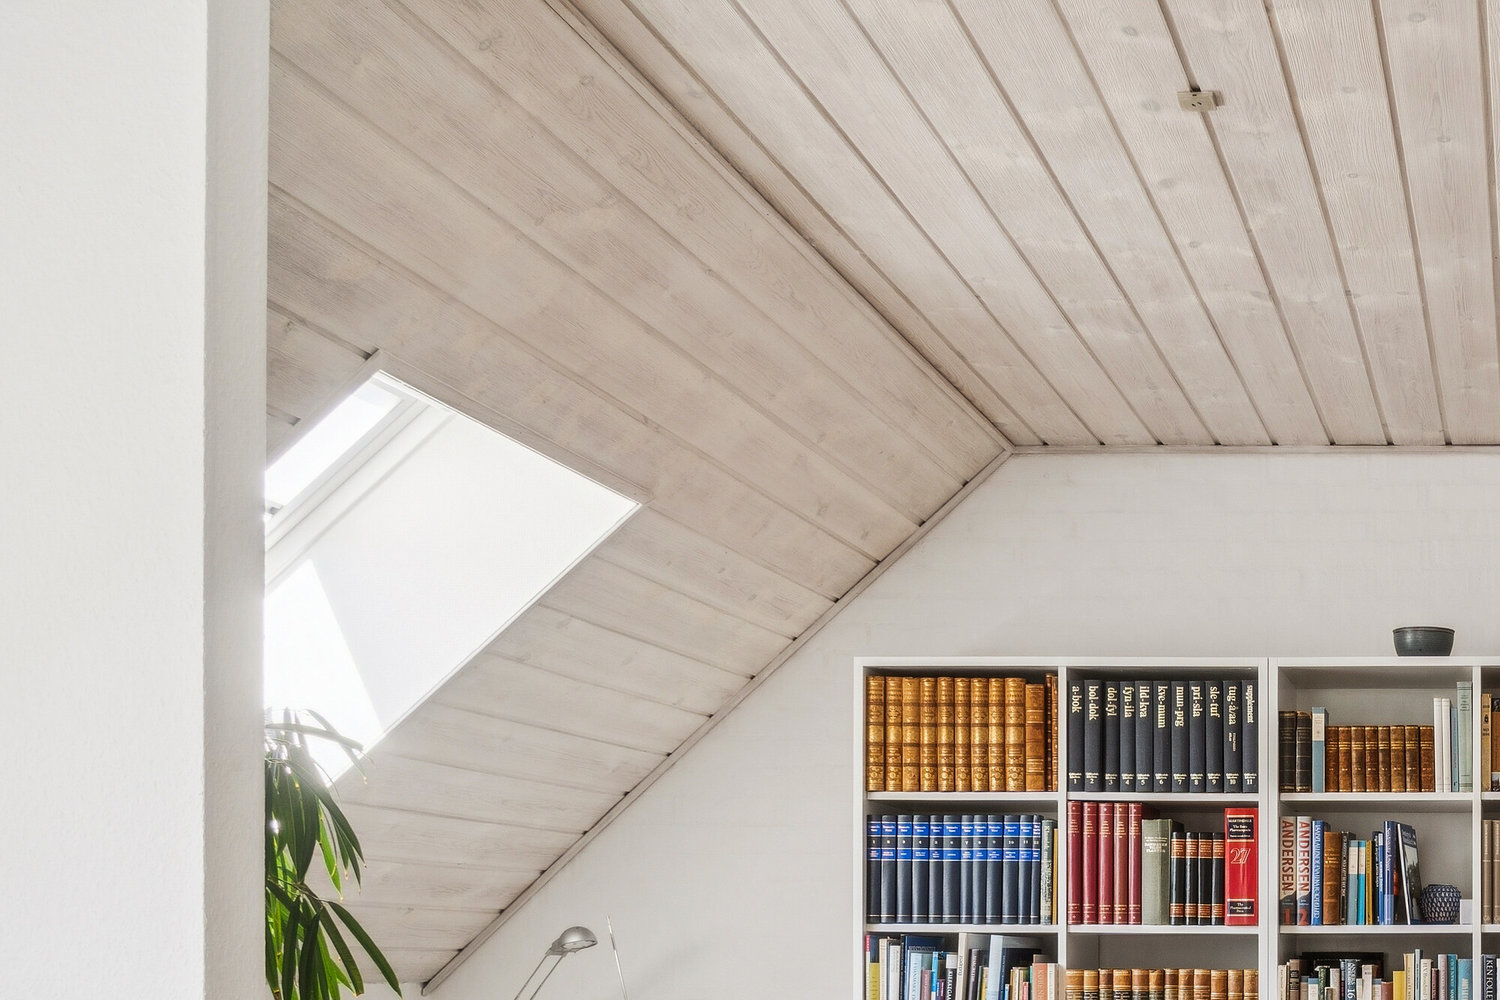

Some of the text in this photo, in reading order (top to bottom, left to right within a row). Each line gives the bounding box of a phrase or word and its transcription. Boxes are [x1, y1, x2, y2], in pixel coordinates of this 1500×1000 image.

[1230, 848, 1251, 864] 27
[1282, 820, 1294, 891] ANDERSEN
[1299, 821, 1310, 891] ANDERSEN
[1347, 988, 1355, 999] 16
